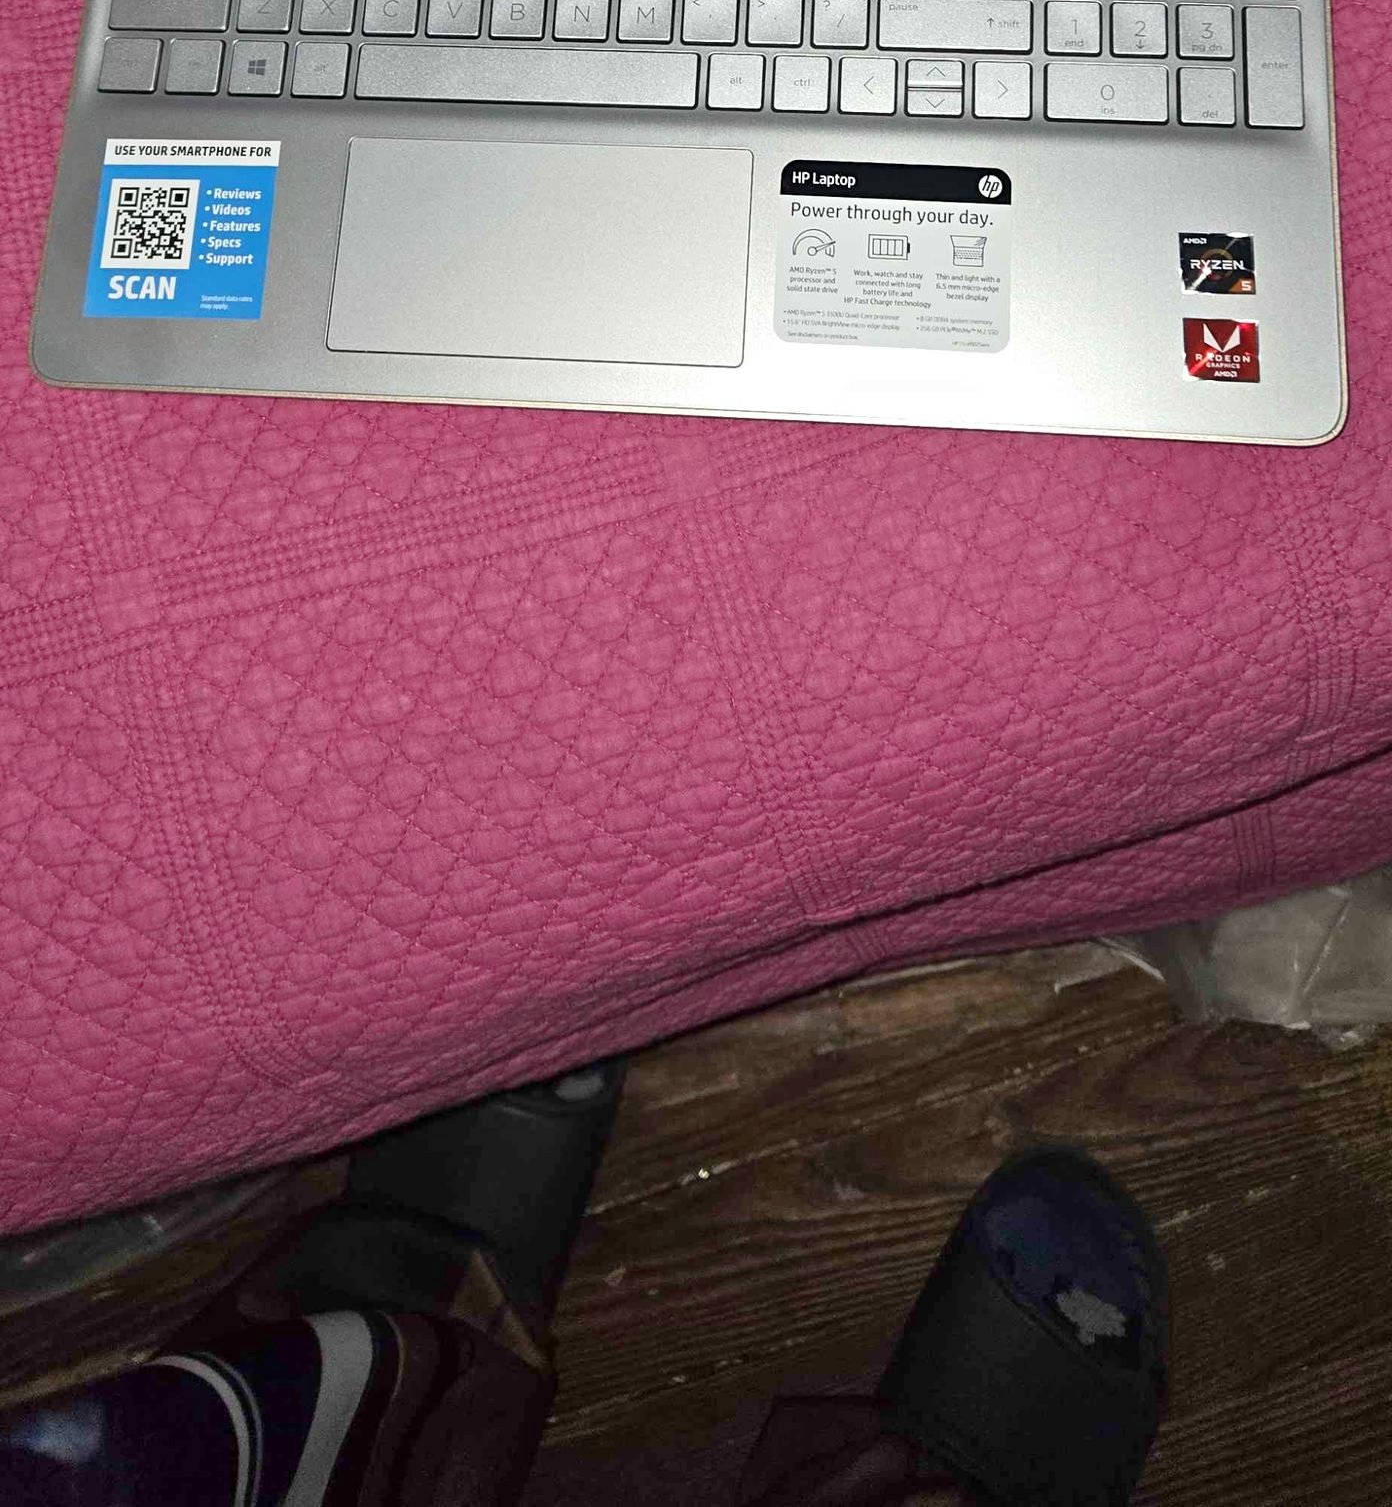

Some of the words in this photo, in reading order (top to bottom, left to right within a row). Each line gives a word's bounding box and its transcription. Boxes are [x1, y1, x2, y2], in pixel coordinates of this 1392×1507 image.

[383, 0, 399, 17] C
[446, 2, 463, 19] V
[510, 3, 525, 20] B
[889, 3, 918, 12] pause
[574, 6, 590, 22] N
[637, 7, 655, 24] M
[998, 19, 1020, 28] shift
[1135, 21, 1146, 36] 2
[1201, 23, 1213, 39] 3
[1064, 39, 1084, 47] end
[1262, 61, 1289, 70] enter
[730, 75, 742, 85] alt
[794, 77, 811, 87] ctrl
[1202, 110, 1219, 118] del
[115, 145, 135, 155] USE
[138, 146, 167, 156] YOUR
[170, 146, 246, 157] SMARTPHONE
[249, 147, 272, 157] FOR
[792, 172, 810, 184] HP
[812, 173, 856, 188] Laptop
[214, 189, 261, 199] Reviews
[212, 205, 251, 216] Videos
[791, 202, 842, 218] Power
[847, 205, 912, 224] through
[917, 213, 955, 225] your
[959, 210, 993, 228] day.
[210, 221, 261, 232] Features
[208, 237, 241, 250] Specs
[206, 253, 253, 266] Support
[1190, 259, 1245, 270] RYZEN
[964, 275, 979, 283] light
[108, 275, 176, 300] SCAN
[962, 285, 999, 293] micro-edge
[1241, 281, 1251, 291] 5
[863, 288, 887, 297] battery
[965, 294, 988, 302] display
[870, 298, 893, 307] Charge
[895, 299, 931, 308] technology
[1195, 354, 1250, 362] RDEON
